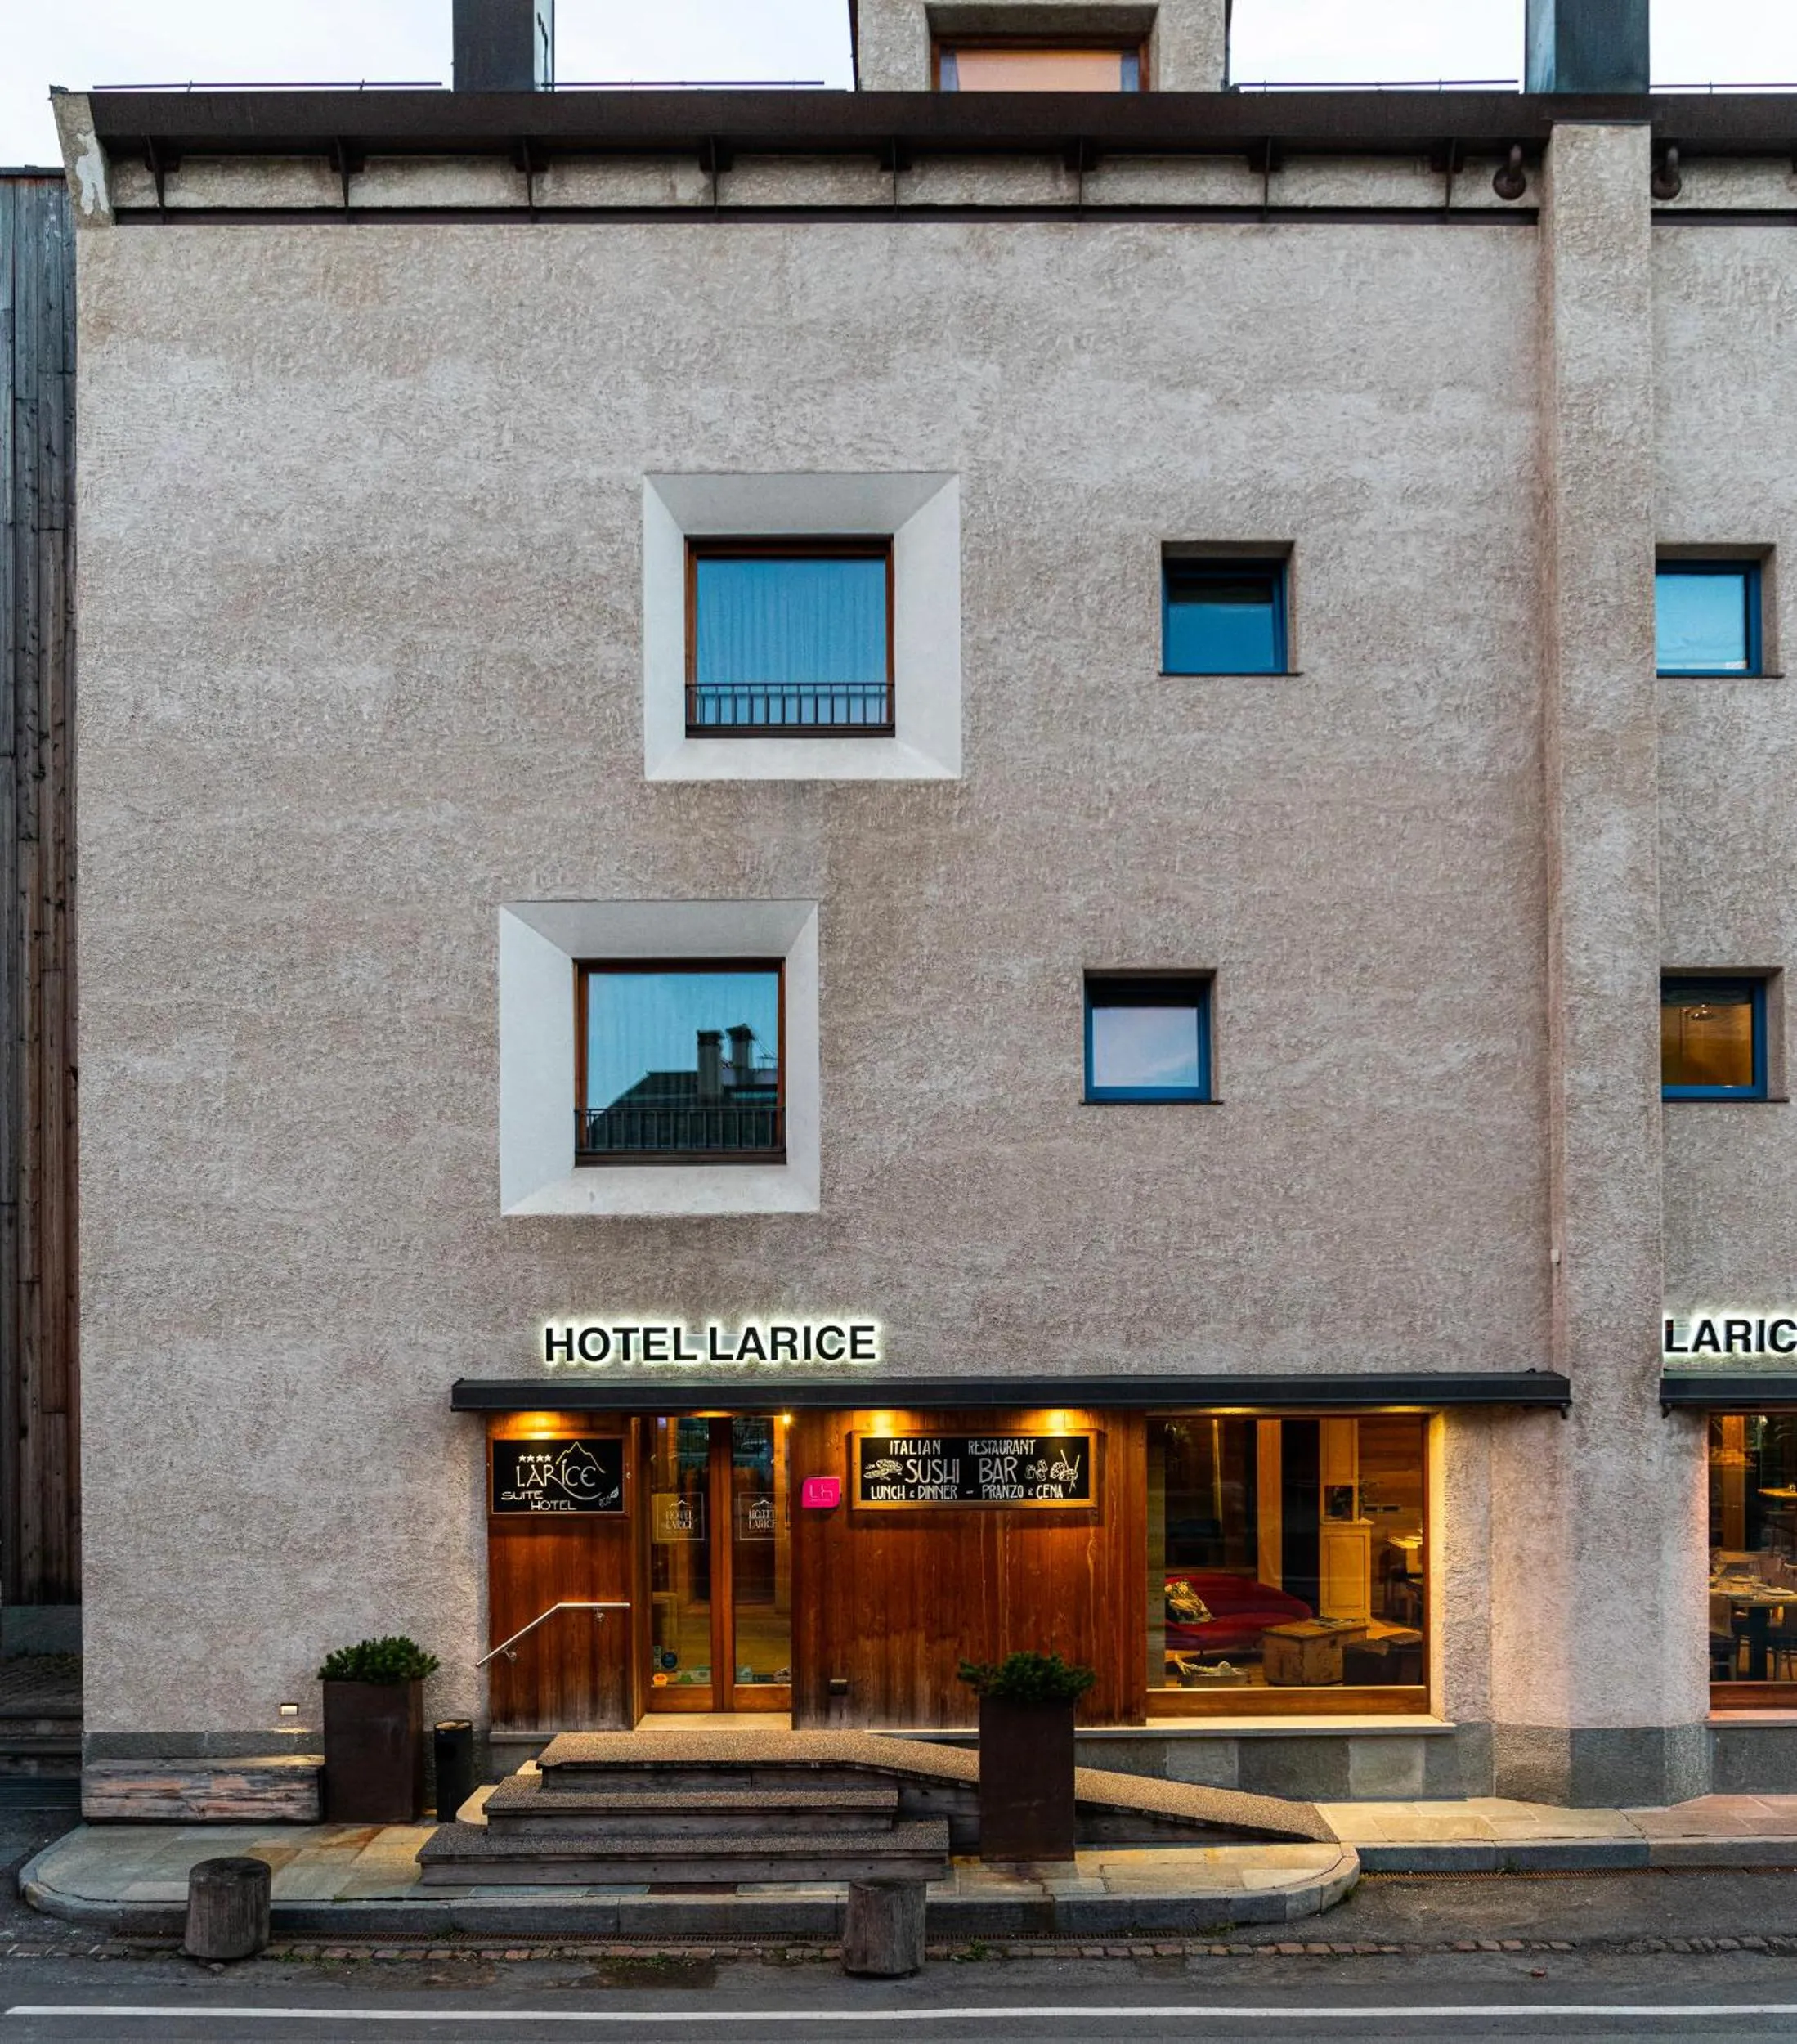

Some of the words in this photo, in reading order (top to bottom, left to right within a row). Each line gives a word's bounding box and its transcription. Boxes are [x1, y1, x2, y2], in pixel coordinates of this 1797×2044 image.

[545, 1326, 697, 1361] HOTEL
[709, 1325, 876, 1360] LARICE
[1664, 1319, 1797, 1353] LARIC
[889, 1440, 941, 1455] ITALIAN
[968, 1439, 1036, 1455] RESTAURANT
[516, 1459, 598, 1491] LARICE
[904, 1459, 960, 1484] SUSHI
[979, 1456, 1018, 1483] BAR
[501, 1490, 543, 1500] SUITE
[871, 1485, 905, 1499] LUNCH
[917, 1485, 957, 1499] DINNER
[982, 1484, 1024, 1499] PRANZO
[1036, 1484, 1064, 1499] CENA
[531, 1499, 576, 1511] HOTEL
